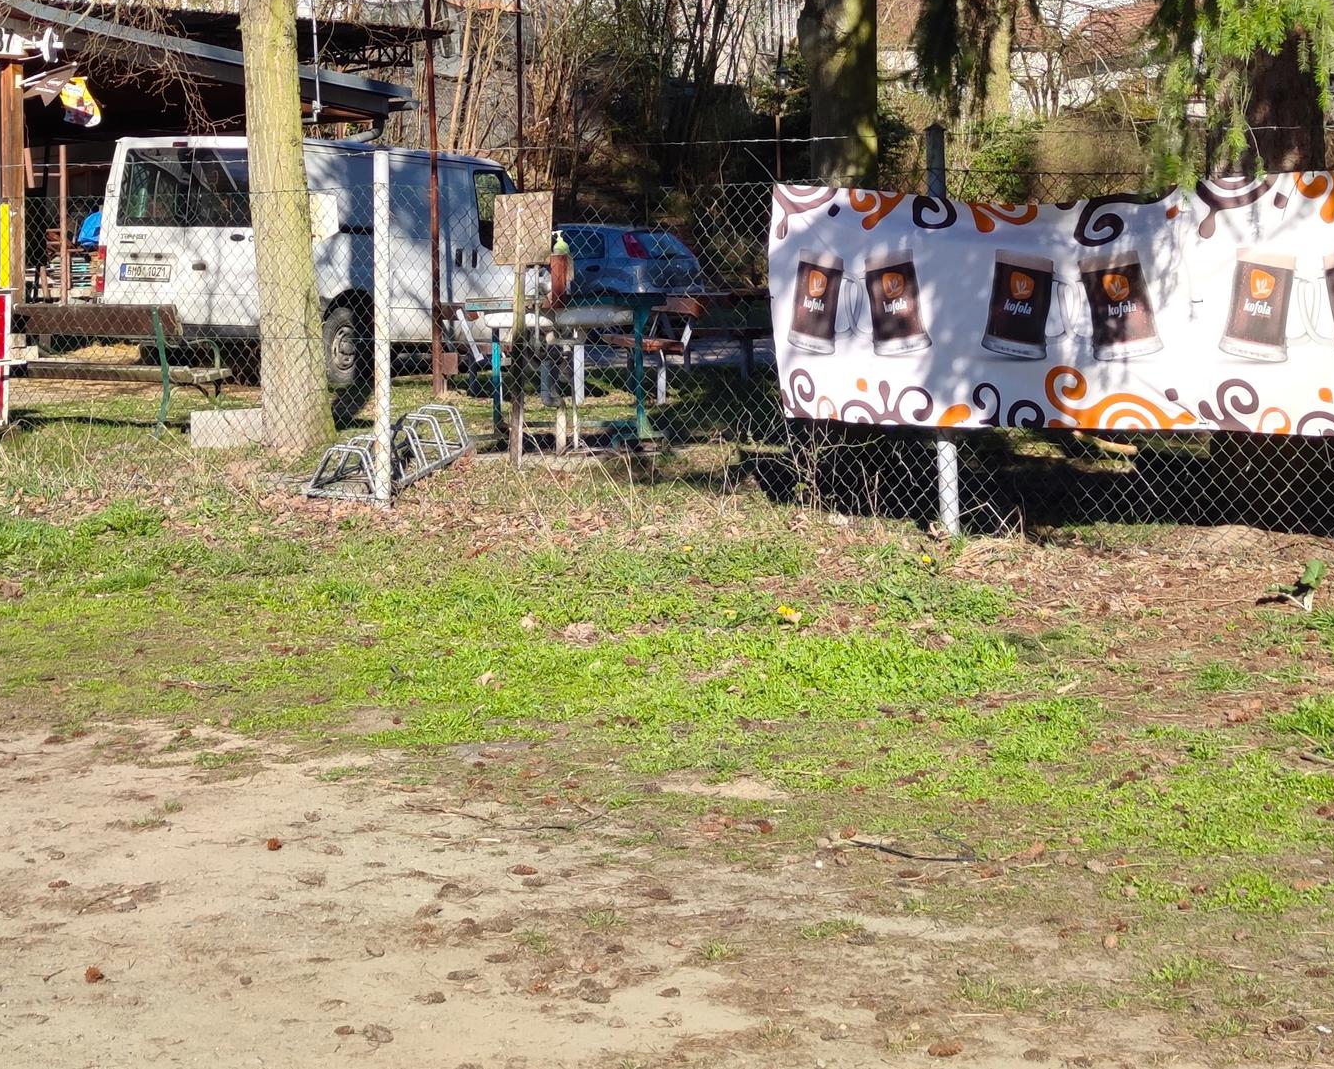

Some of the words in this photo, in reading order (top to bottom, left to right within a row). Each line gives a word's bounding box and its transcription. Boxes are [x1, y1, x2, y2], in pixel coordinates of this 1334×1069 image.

[803, 295, 825, 312] kofola
[883, 298, 907, 315] kofola
[1003, 299, 1032, 315] kofola
[1108, 301, 1137, 317] kofola
[1243, 299, 1272, 316] kofola
